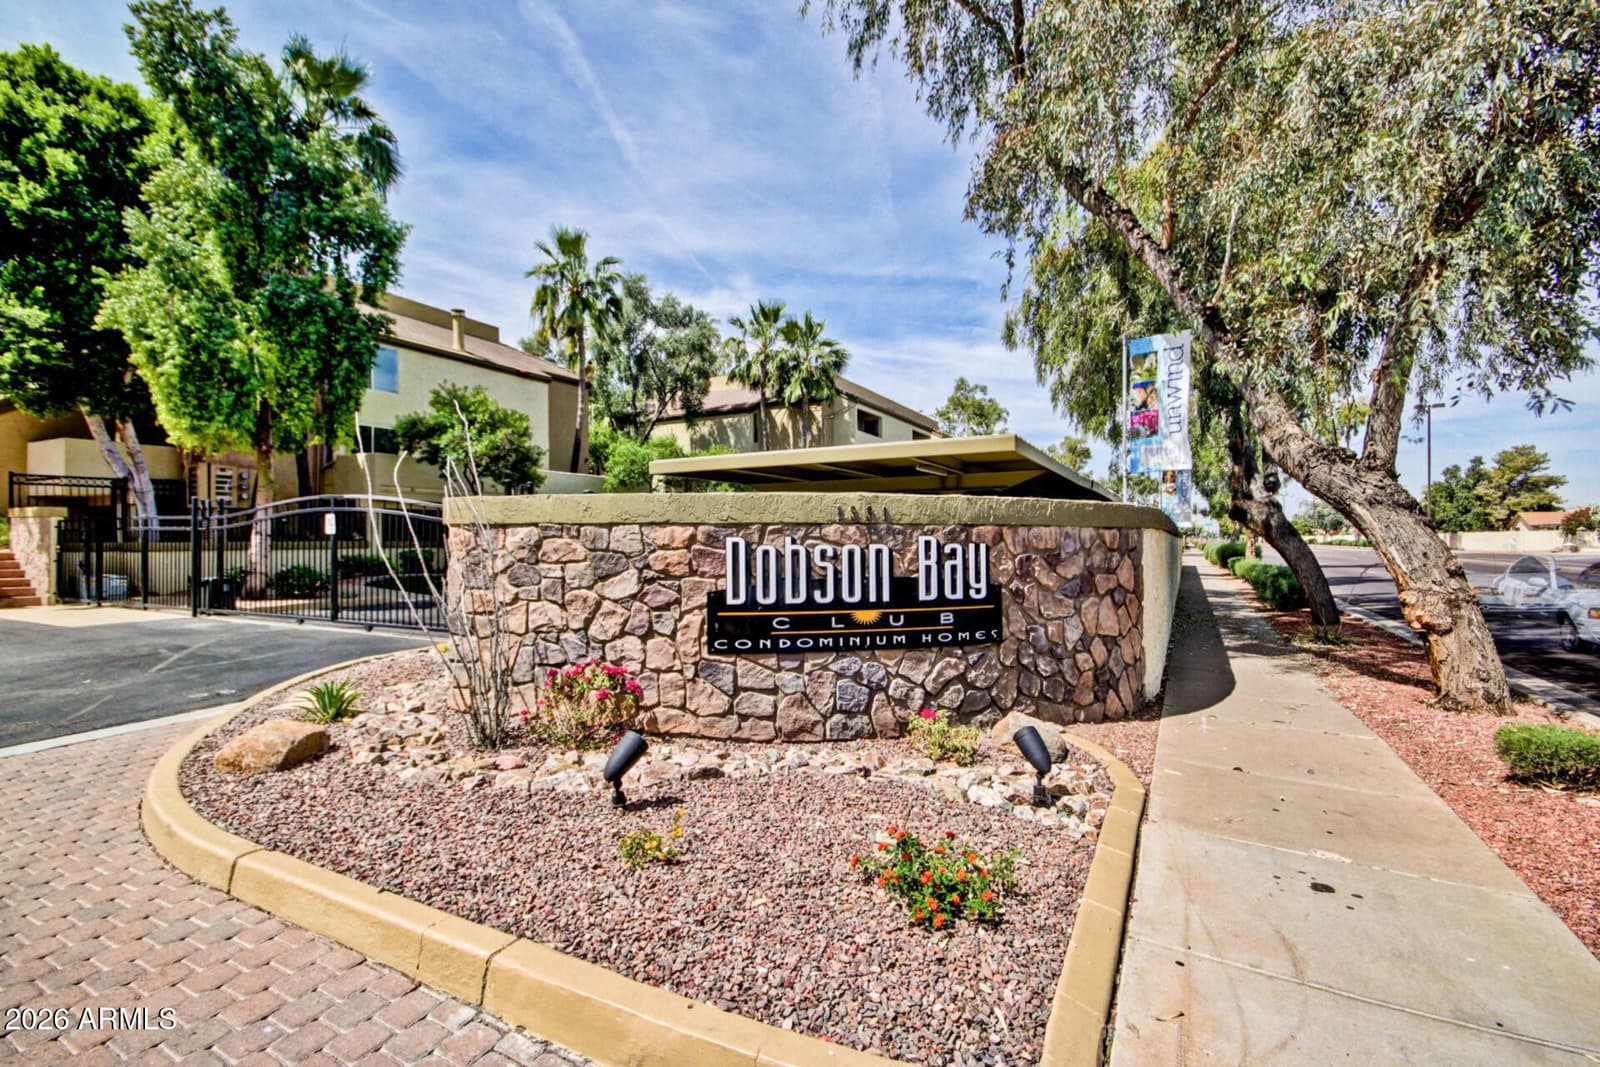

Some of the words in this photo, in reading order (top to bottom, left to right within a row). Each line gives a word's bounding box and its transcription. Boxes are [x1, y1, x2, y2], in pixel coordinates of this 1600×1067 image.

[1163, 343, 1185, 435] unwind
[725, 536, 890, 605] Dobson
[918, 535, 988, 601] Bay
